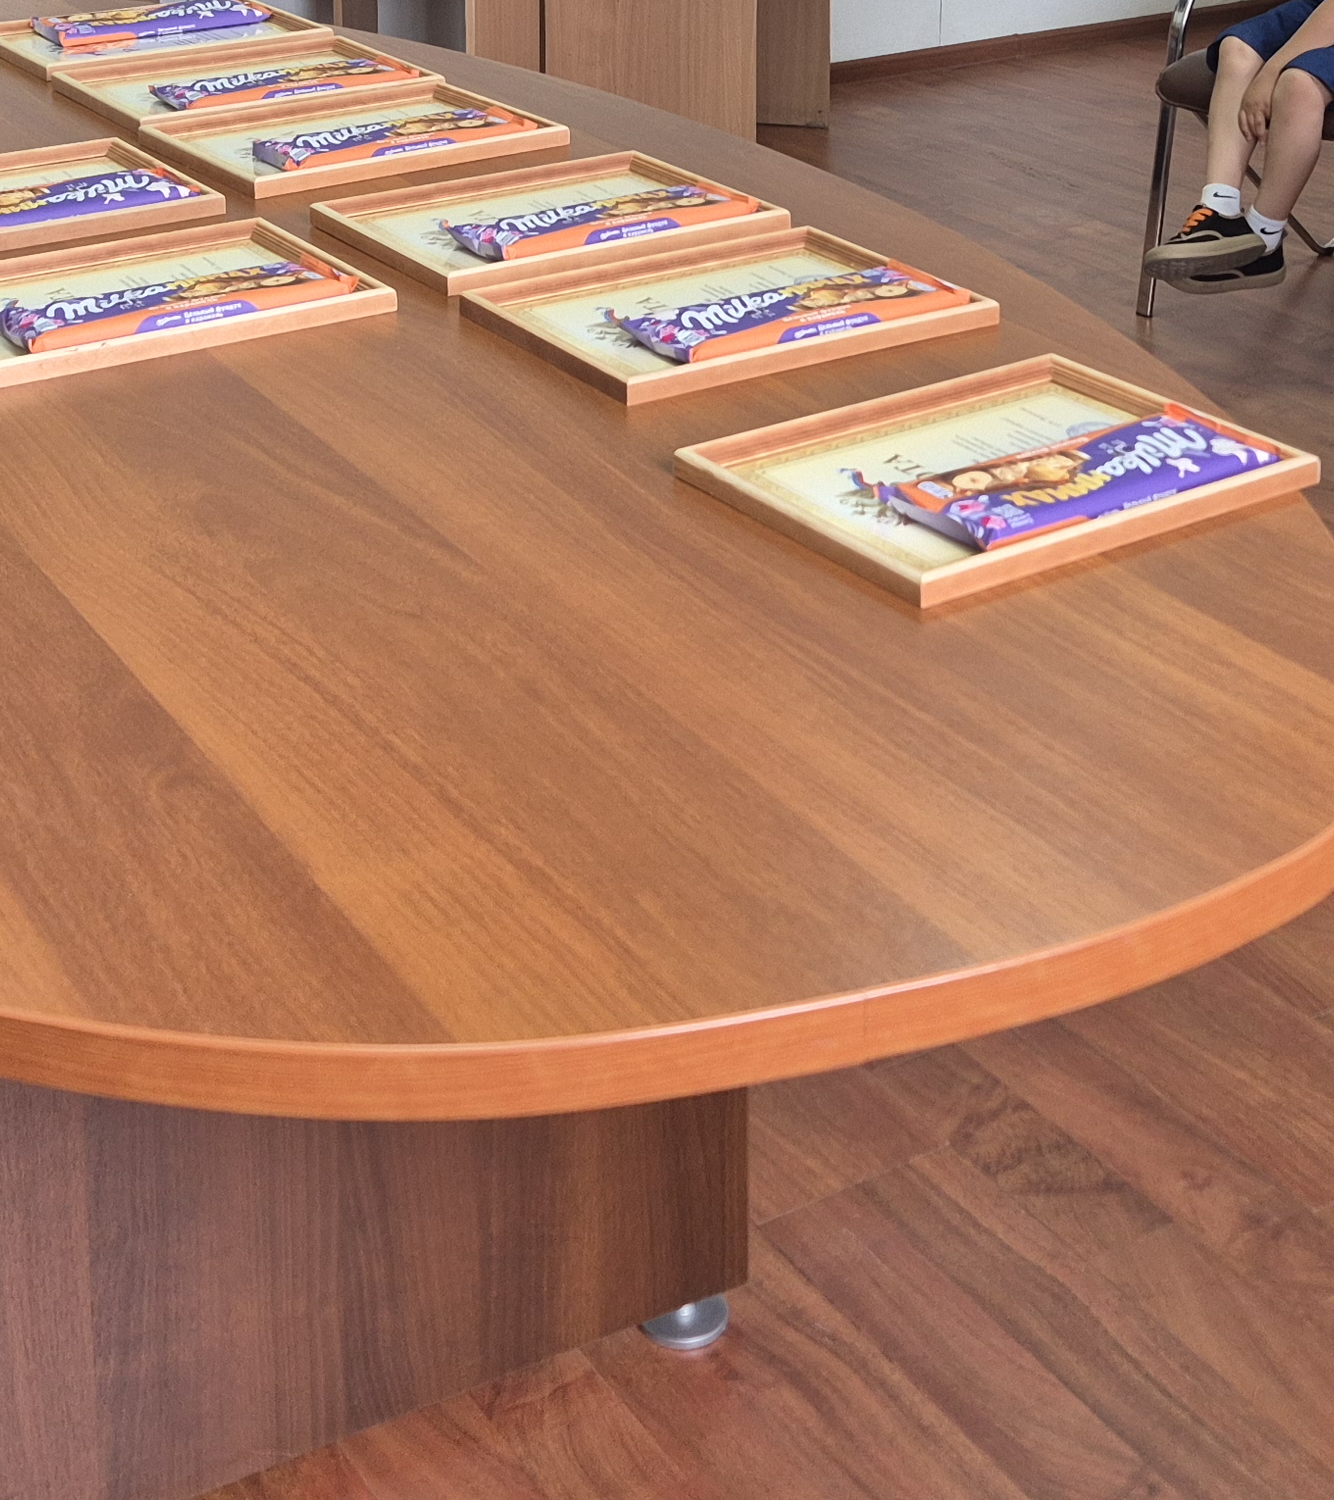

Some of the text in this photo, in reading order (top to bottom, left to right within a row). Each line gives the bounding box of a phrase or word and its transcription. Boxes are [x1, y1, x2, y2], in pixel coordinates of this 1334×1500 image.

[192, 69, 282, 93] Milka
[295, 121, 389, 150] Milka
[45, 173, 151, 203] Milka
[501, 204, 597, 233] Milka
[46, 283, 174, 322] Milka
[680, 290, 787, 331] Milka
[1097, 425, 1210, 477] Milka
